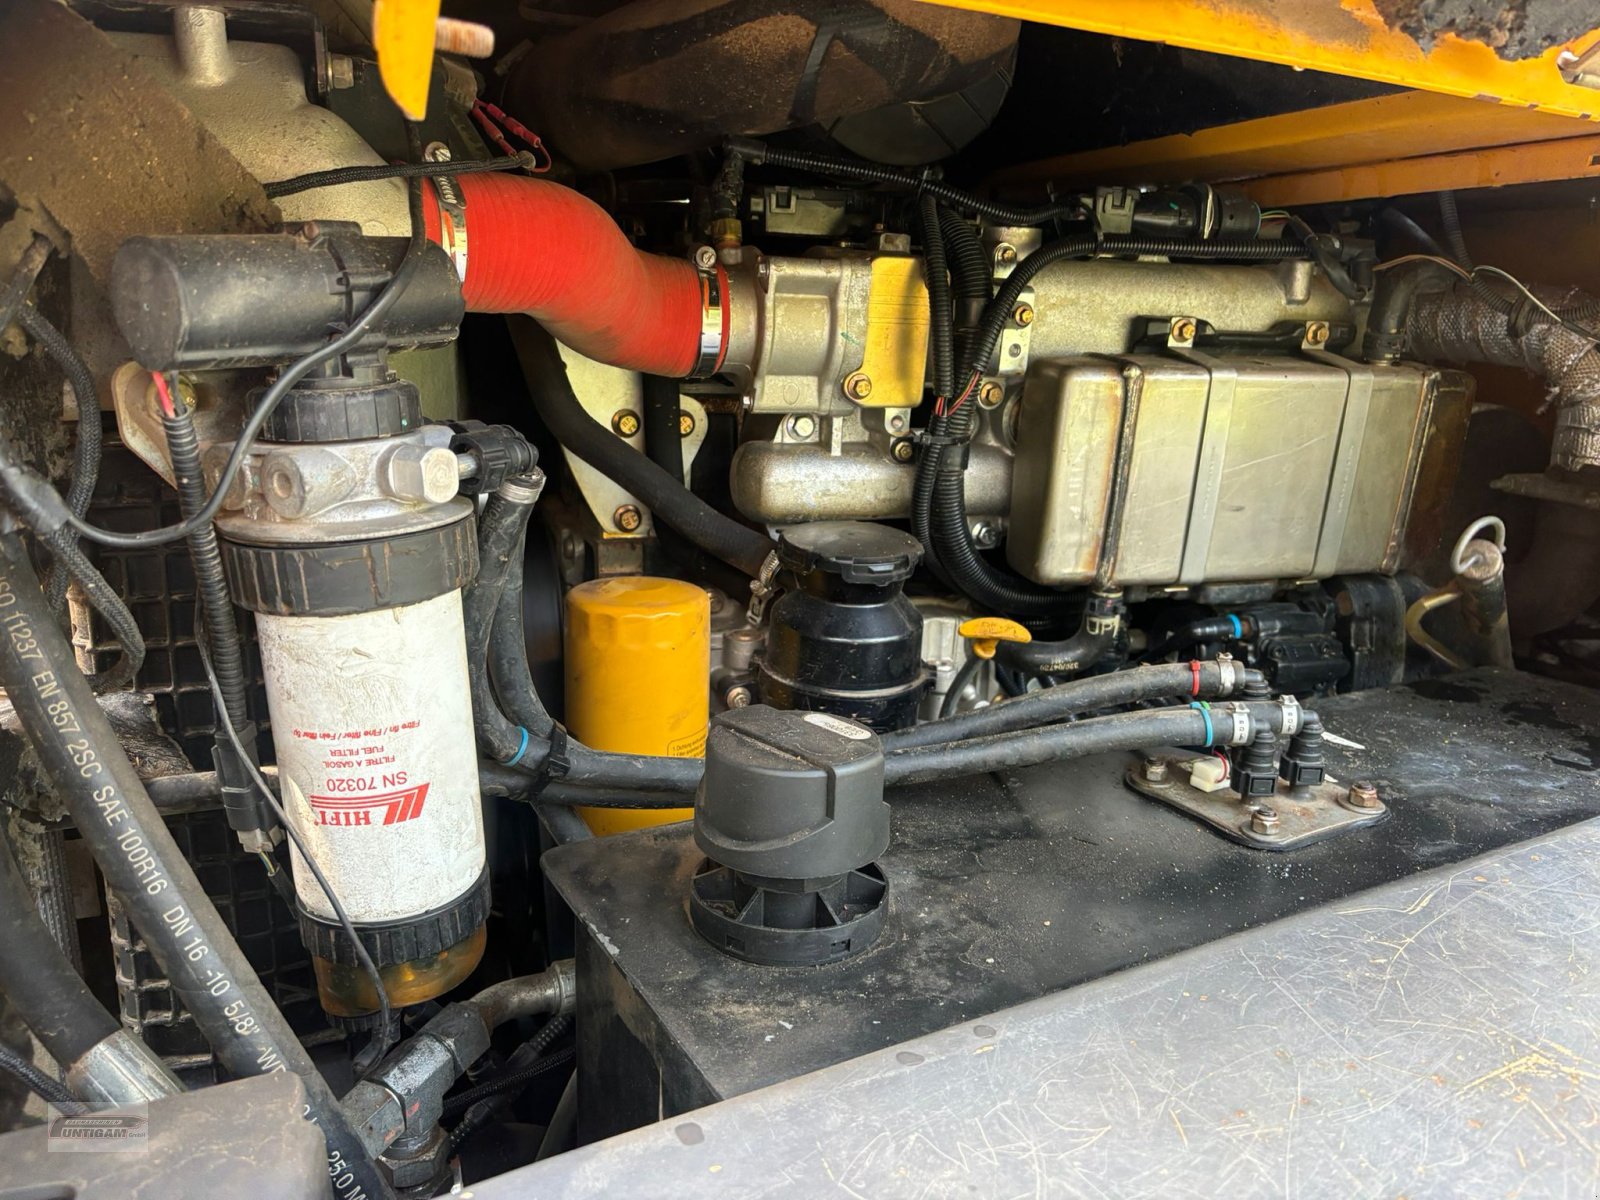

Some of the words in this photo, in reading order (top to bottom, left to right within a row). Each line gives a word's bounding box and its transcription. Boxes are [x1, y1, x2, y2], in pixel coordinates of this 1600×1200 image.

[401, 720, 421, 730] Filtre
[329, 749, 359, 757] FILTER
[361, 745, 384, 755] FUEL
[322, 760, 354, 768] GASOIL
[365, 755, 395, 767] FILTRE
[326, 776, 378, 792] 70320
[383, 771, 408, 788] SN
[4, 611, 43, 660] 11237
[32, 670, 61, 699] EN
[47, 701, 81, 734] 857
[67, 739, 103, 778] 2SC
[93, 785, 129, 826] SAE
[117, 827, 168, 896] 100R16
[163, 904, 194, 938] DN
[183, 937, 209, 962] 16
[205, 969, 231, 997] -10
[328, 1150, 354, 1189] 25.0
